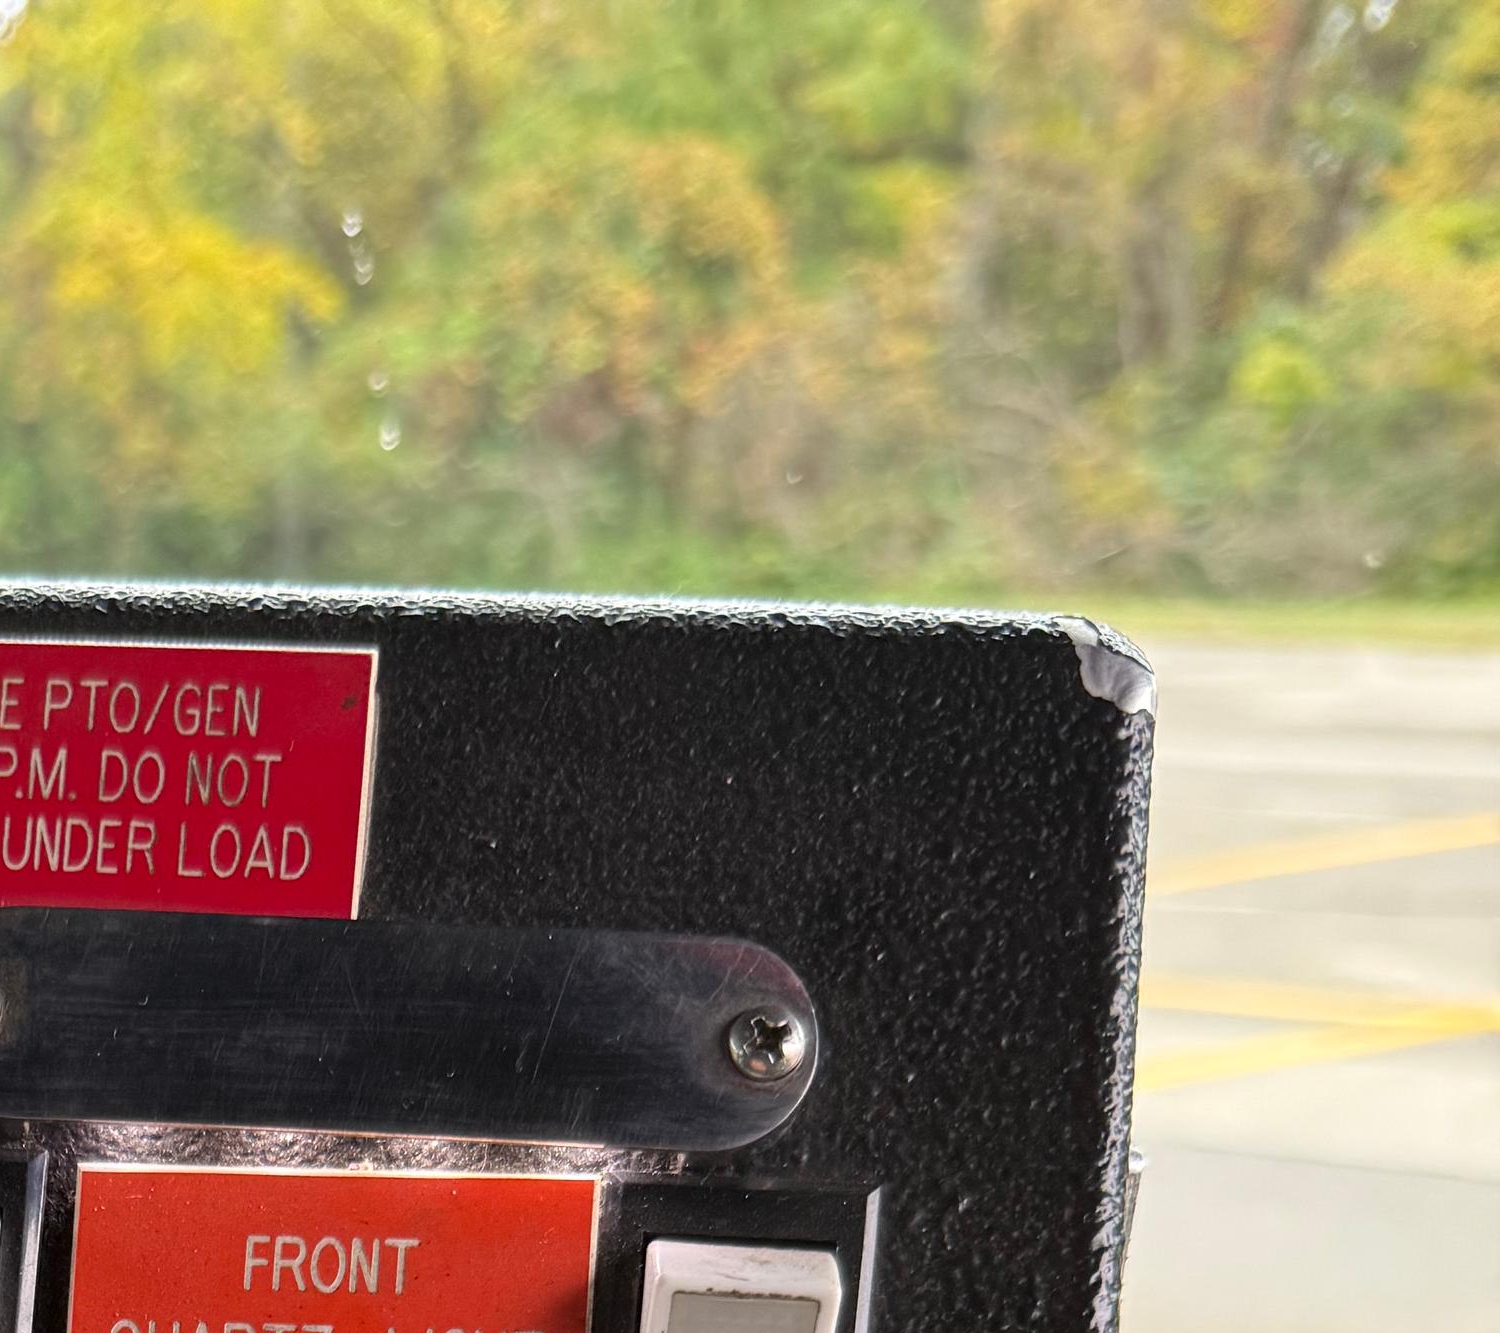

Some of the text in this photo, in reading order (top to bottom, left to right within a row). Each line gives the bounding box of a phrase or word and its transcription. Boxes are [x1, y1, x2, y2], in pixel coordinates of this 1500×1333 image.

[43, 679, 263, 738] PTO/GEN
[99, 749, 165, 805] DO
[185, 752, 283, 809] NOT
[3, 819, 158, 877] UNDER
[178, 825, 311, 881] LOAD
[243, 1235, 420, 1295] FRONT
